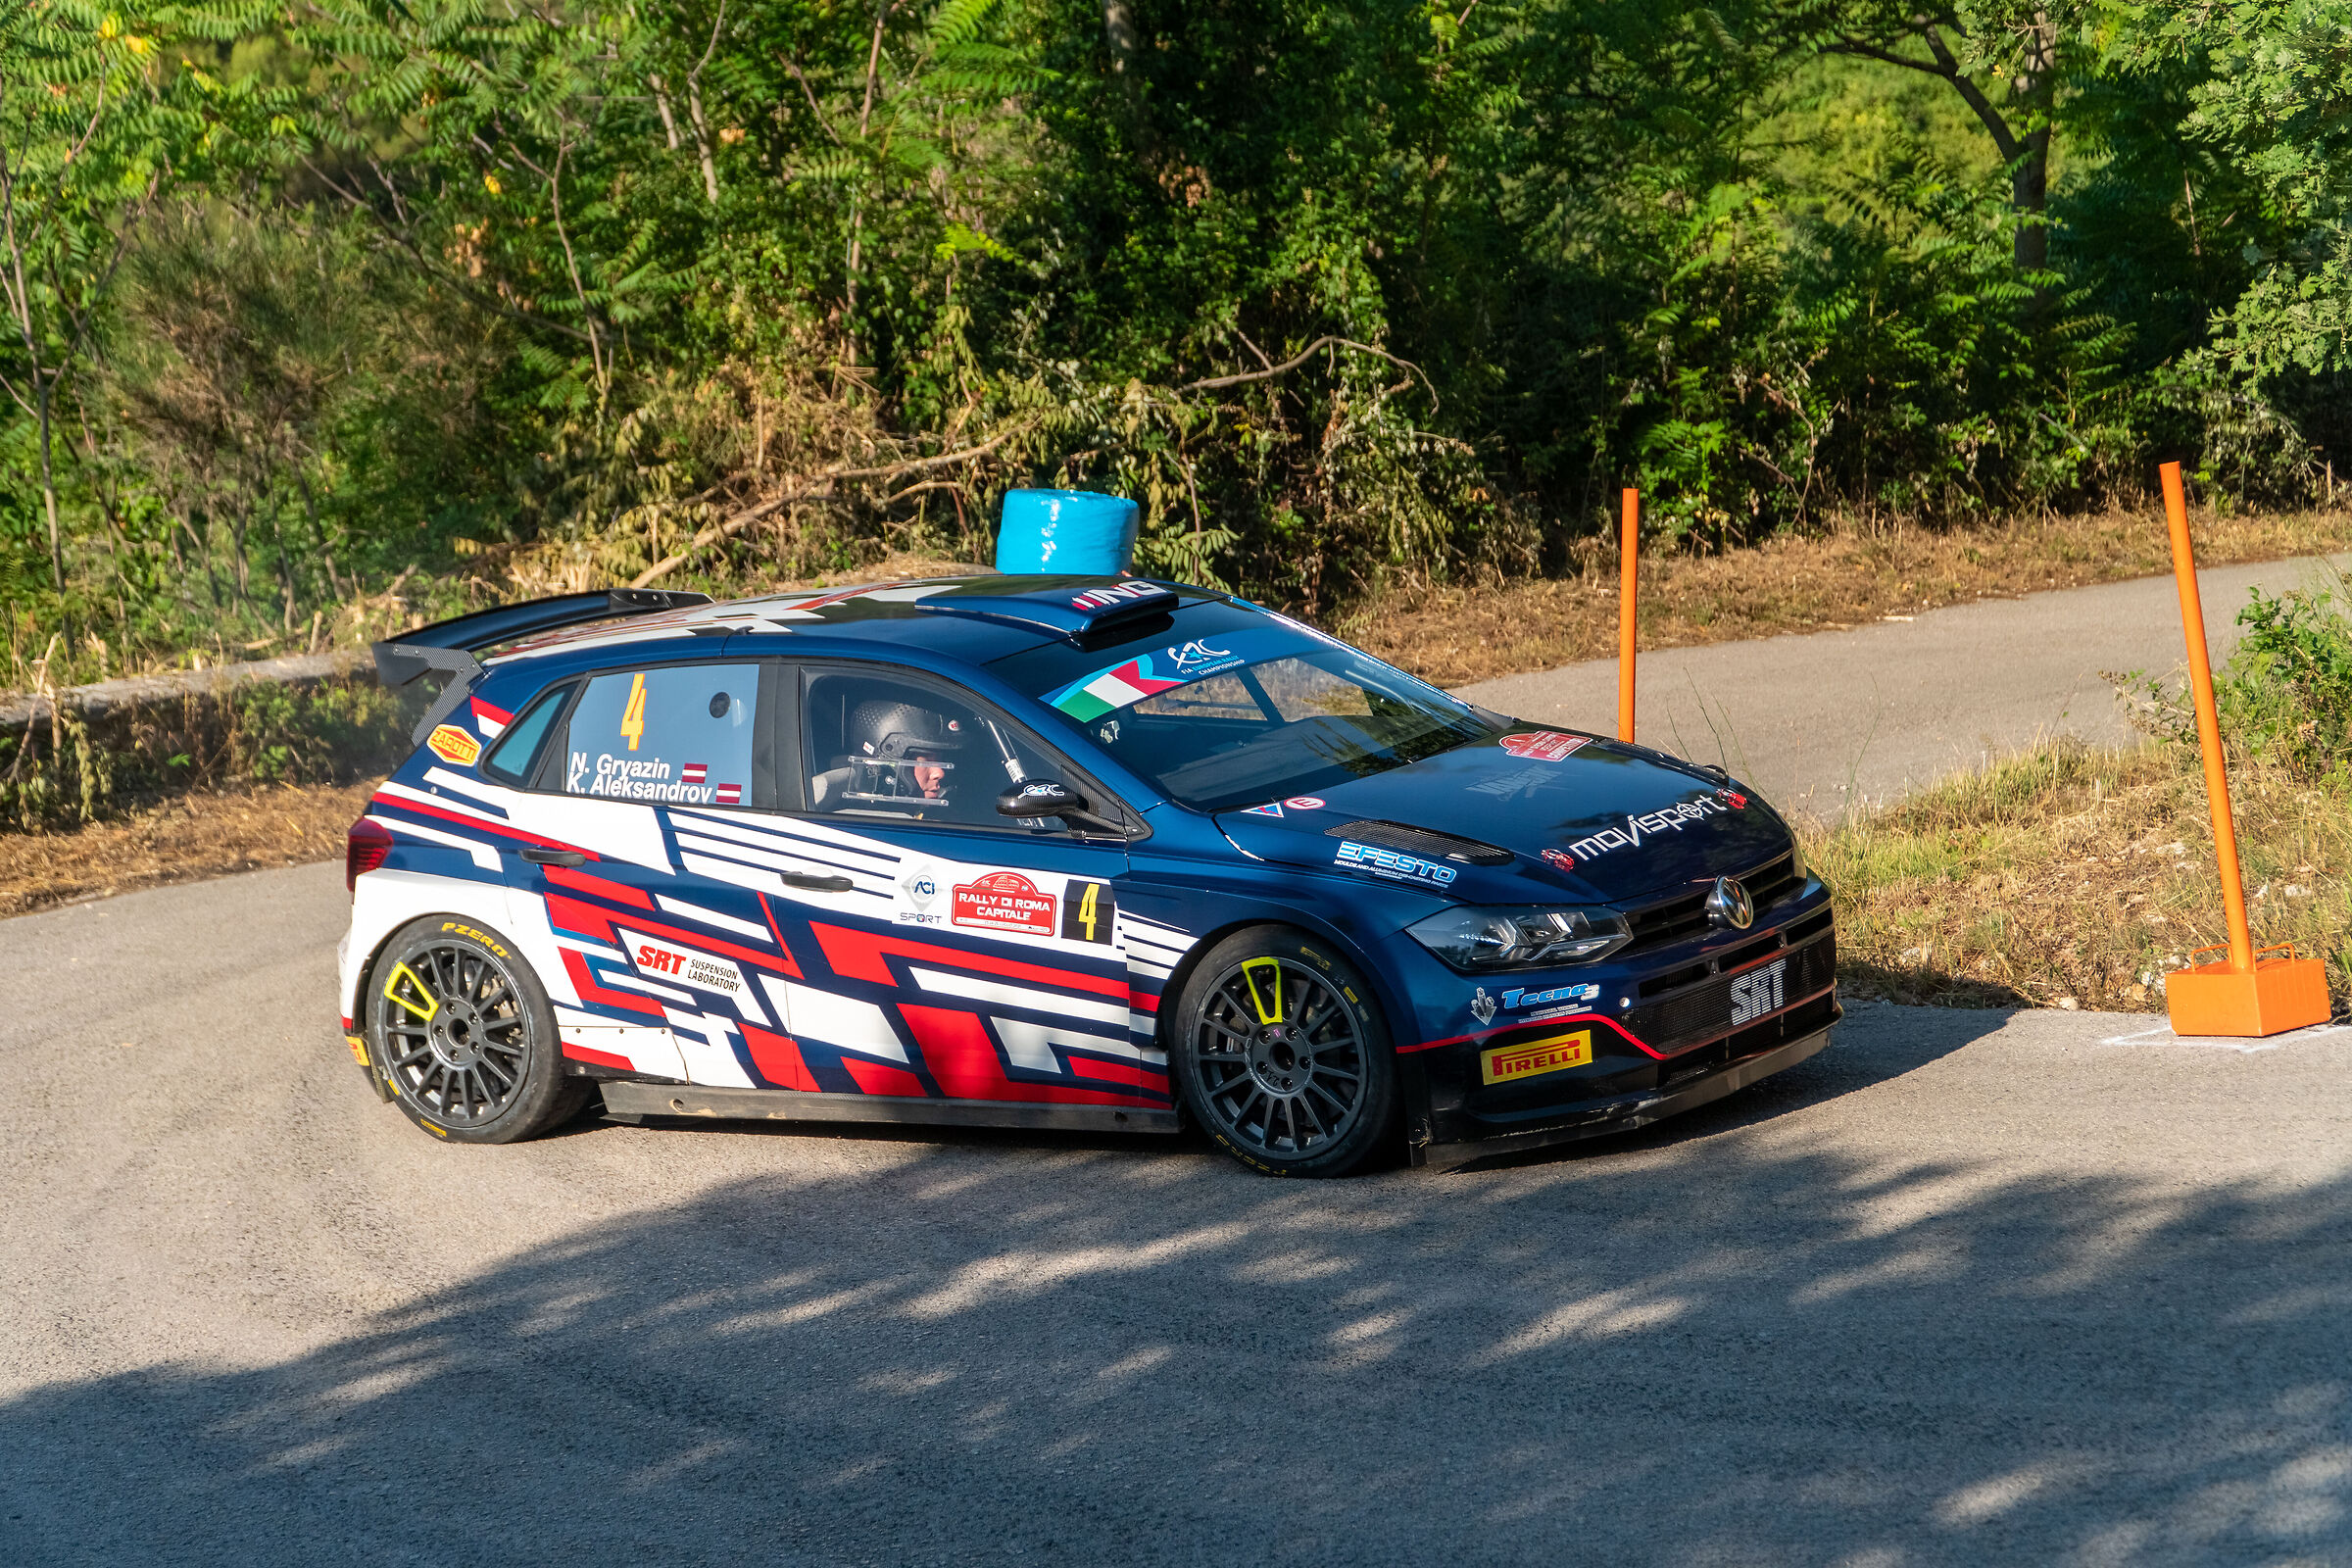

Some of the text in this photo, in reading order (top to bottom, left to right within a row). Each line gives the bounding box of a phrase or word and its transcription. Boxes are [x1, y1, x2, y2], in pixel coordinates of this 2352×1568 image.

[620, 673, 647, 751] 4
[431, 730, 476, 760] ZAROTTI
[569, 752, 671, 781] N. Gryazin
[566, 771, 713, 804] K. Aleksandrov
[1336, 841, 1457, 883] EFESTO
[914, 881, 935, 895] ACI
[958, 892, 1051, 911] RALLY DI ROMA
[900, 912, 942, 923] SPORT
[976, 906, 1032, 921] CAPITALE
[1078, 883, 1100, 941] 4
[636, 945, 687, 975] SRT
[690, 958, 738, 979] SUSPENSION
[687, 969, 741, 992] LABORATORY
[1731, 957, 1787, 1026] SRT
[1492, 1039, 1581, 1076] PIRELLI
